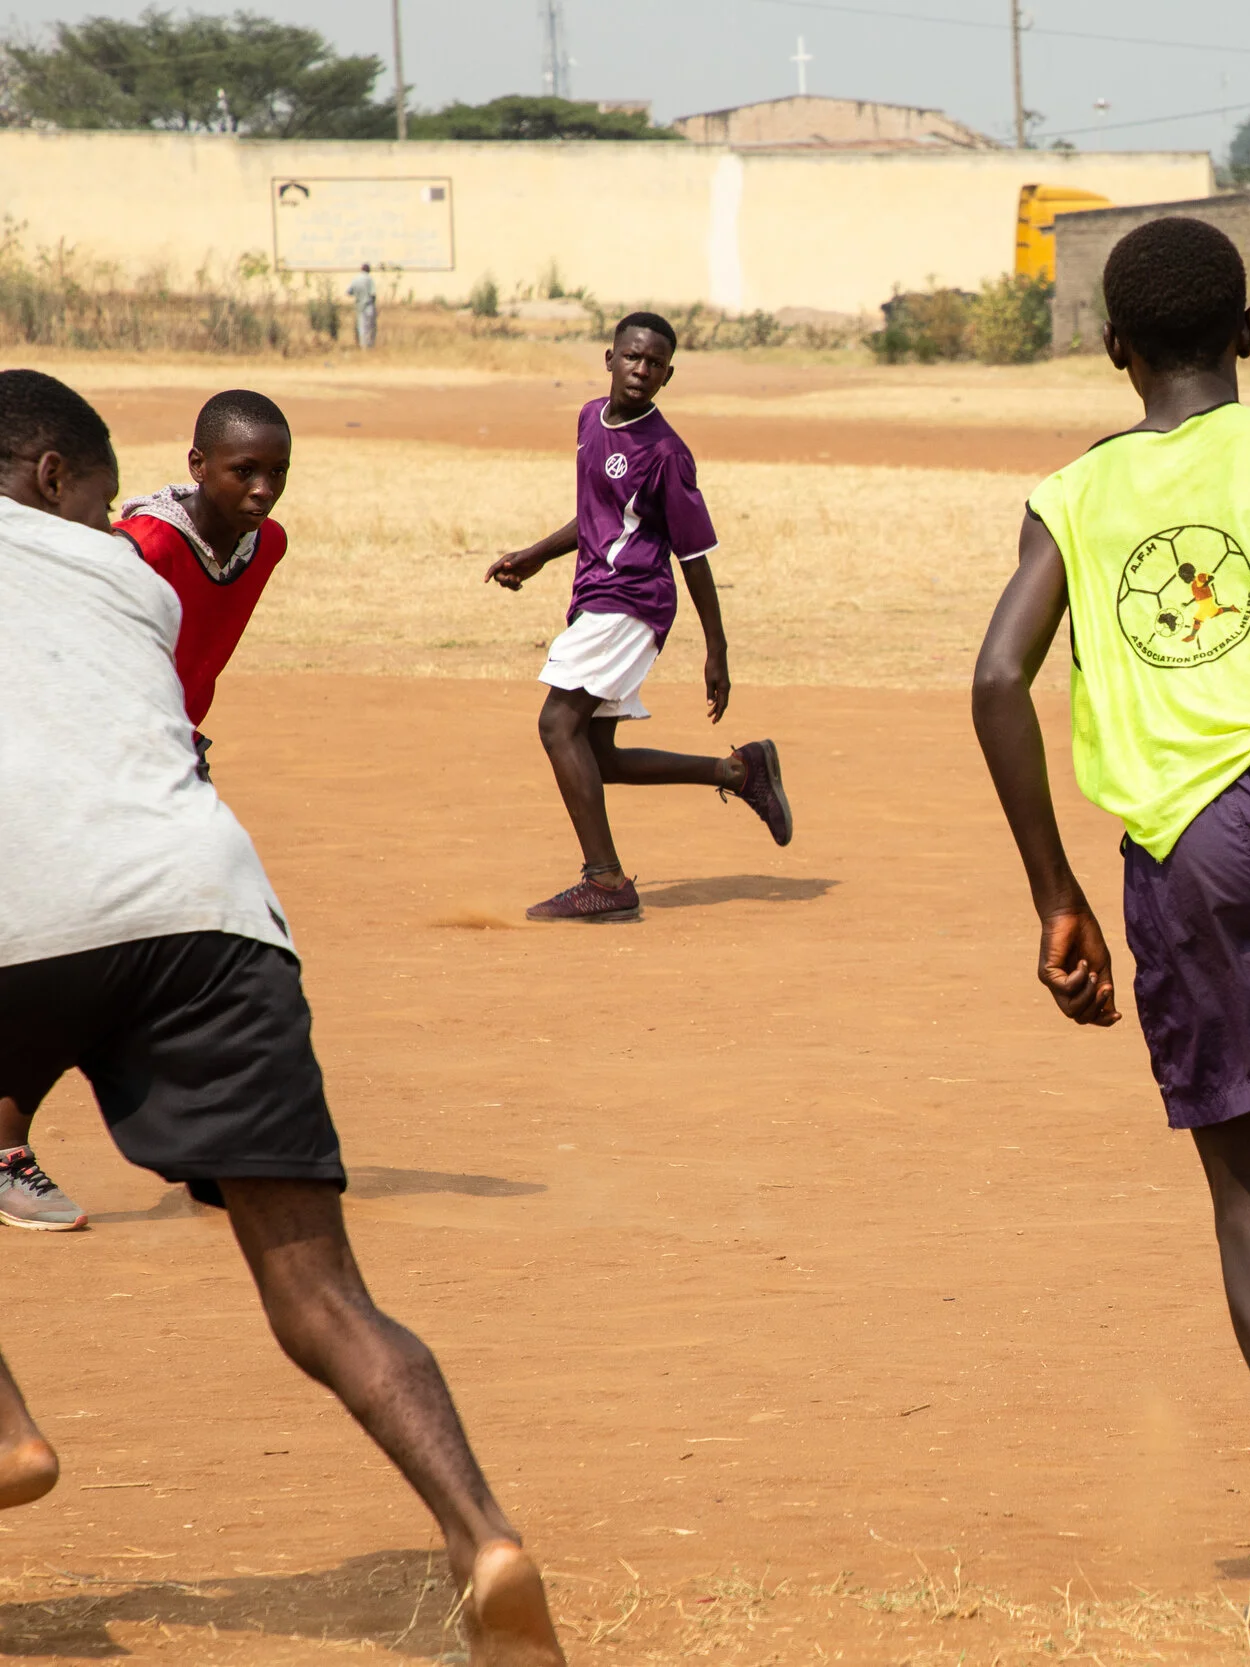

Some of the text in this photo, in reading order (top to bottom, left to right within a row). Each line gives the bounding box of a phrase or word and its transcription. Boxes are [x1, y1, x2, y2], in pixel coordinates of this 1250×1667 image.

[1130, 542, 1157, 574] A.F.H
[1131, 635, 1191, 663] ASSOCIATION
[1193, 631, 1242, 661] FOOTBALL
